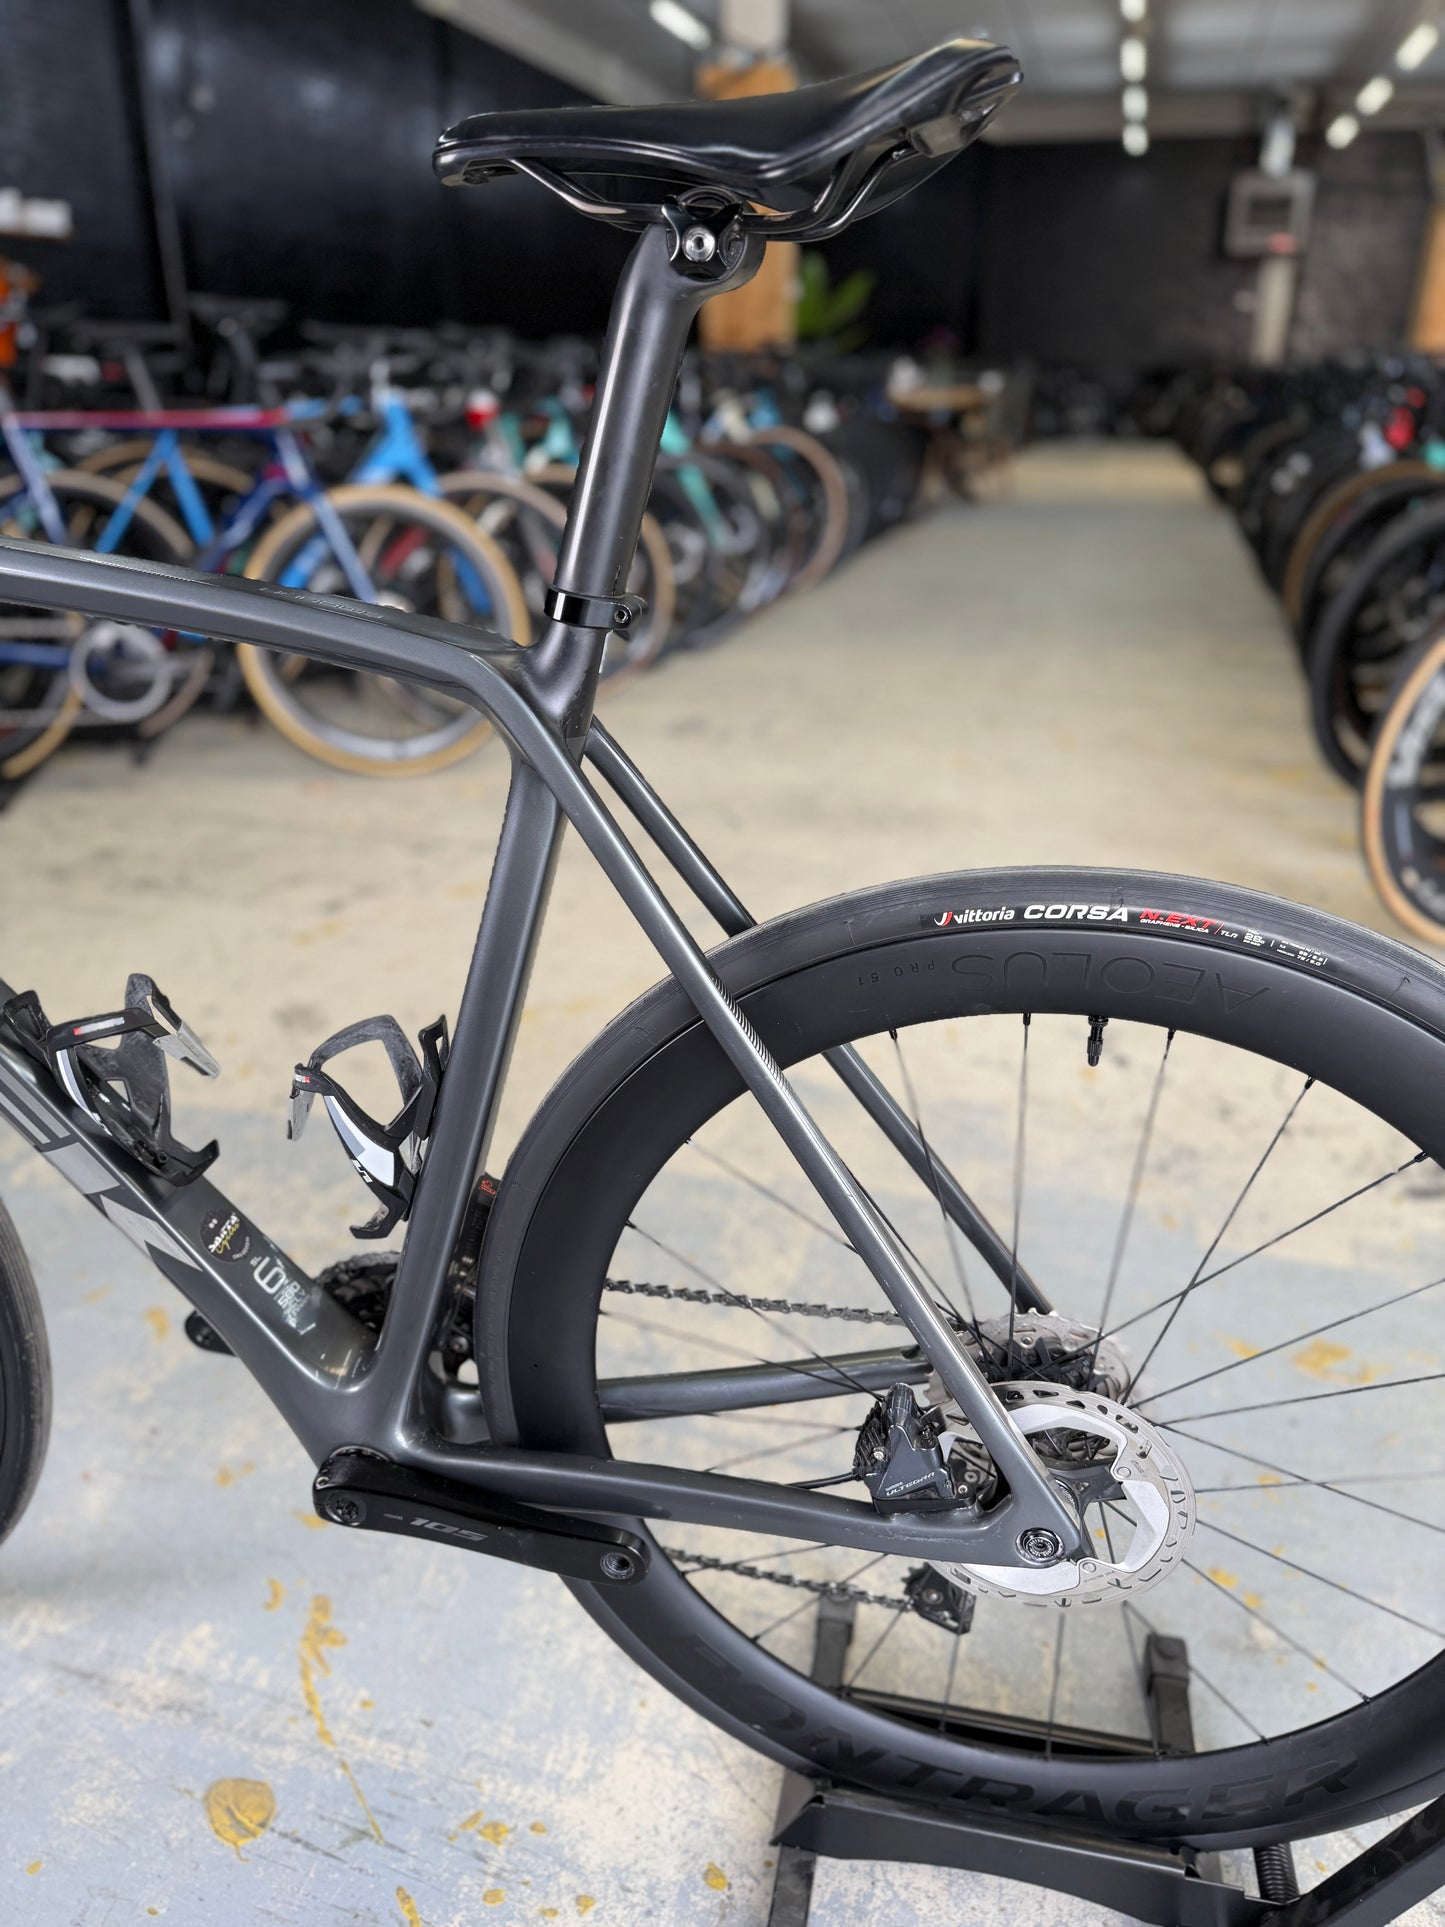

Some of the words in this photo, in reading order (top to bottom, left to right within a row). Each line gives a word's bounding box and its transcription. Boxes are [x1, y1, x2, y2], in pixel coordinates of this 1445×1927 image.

[953, 907, 1016, 925] vittoria
[1023, 904, 1129, 923] CORSA
[1139, 909, 1217, 929] N.EXT
[858, 972, 880, 987] 51
[894, 960, 937, 978] PRO
[951, 951, 1272, 1016] AEOLUS
[250, 1256, 263, 1267] SL
[253, 1256, 287, 1295] 6
[886, 1471, 936, 1497] ULTEGRA
[409, 1517, 489, 1542] 105
